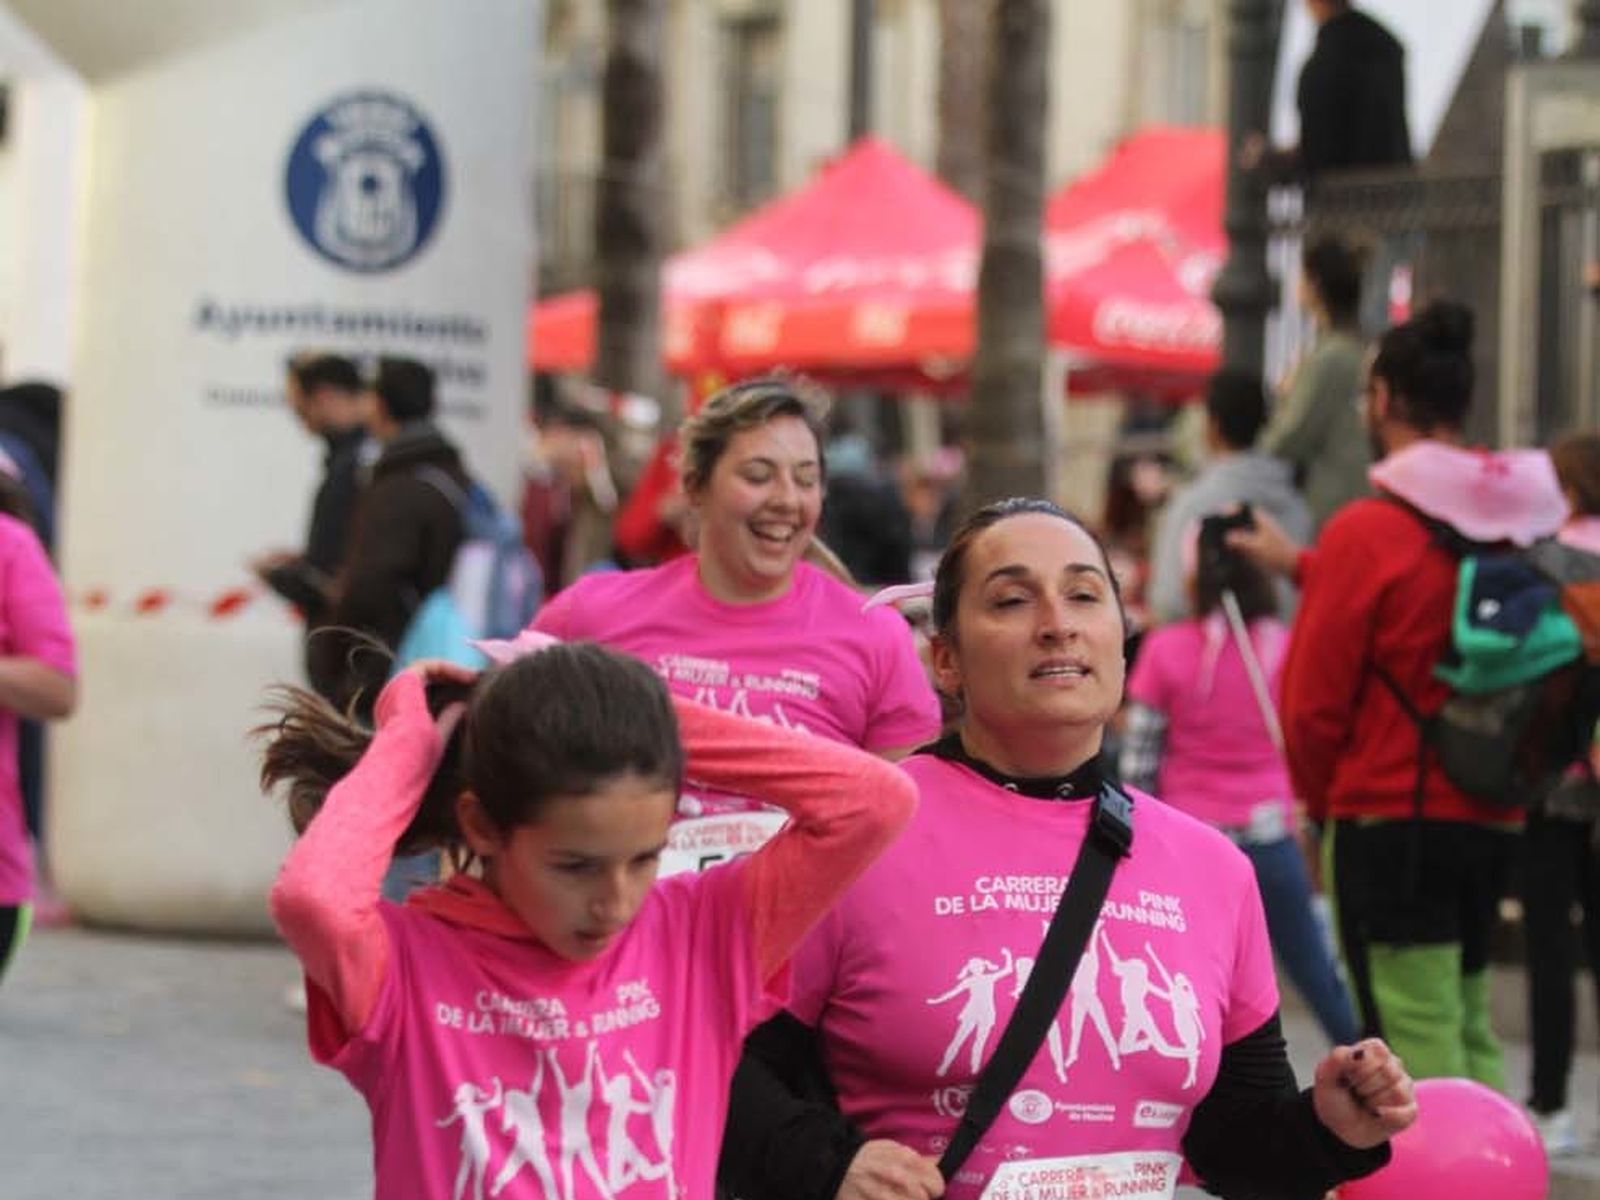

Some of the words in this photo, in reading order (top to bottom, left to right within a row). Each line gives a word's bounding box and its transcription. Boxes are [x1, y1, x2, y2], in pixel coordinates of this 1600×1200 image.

[935, 897, 965, 915] DE
[970, 894, 999, 911] LA
[1005, 894, 1061, 912] MUJE
[1101, 901, 1186, 932] RUNNING
[1139, 891, 1181, 913] PINK
[436, 1003, 464, 1029] DE
[467, 1013, 495, 1034] LA
[1018, 1167, 1084, 1187] CARRERA
[1134, 1162, 1169, 1177] PINK
[1104, 1178, 1167, 1197] RUNNING
